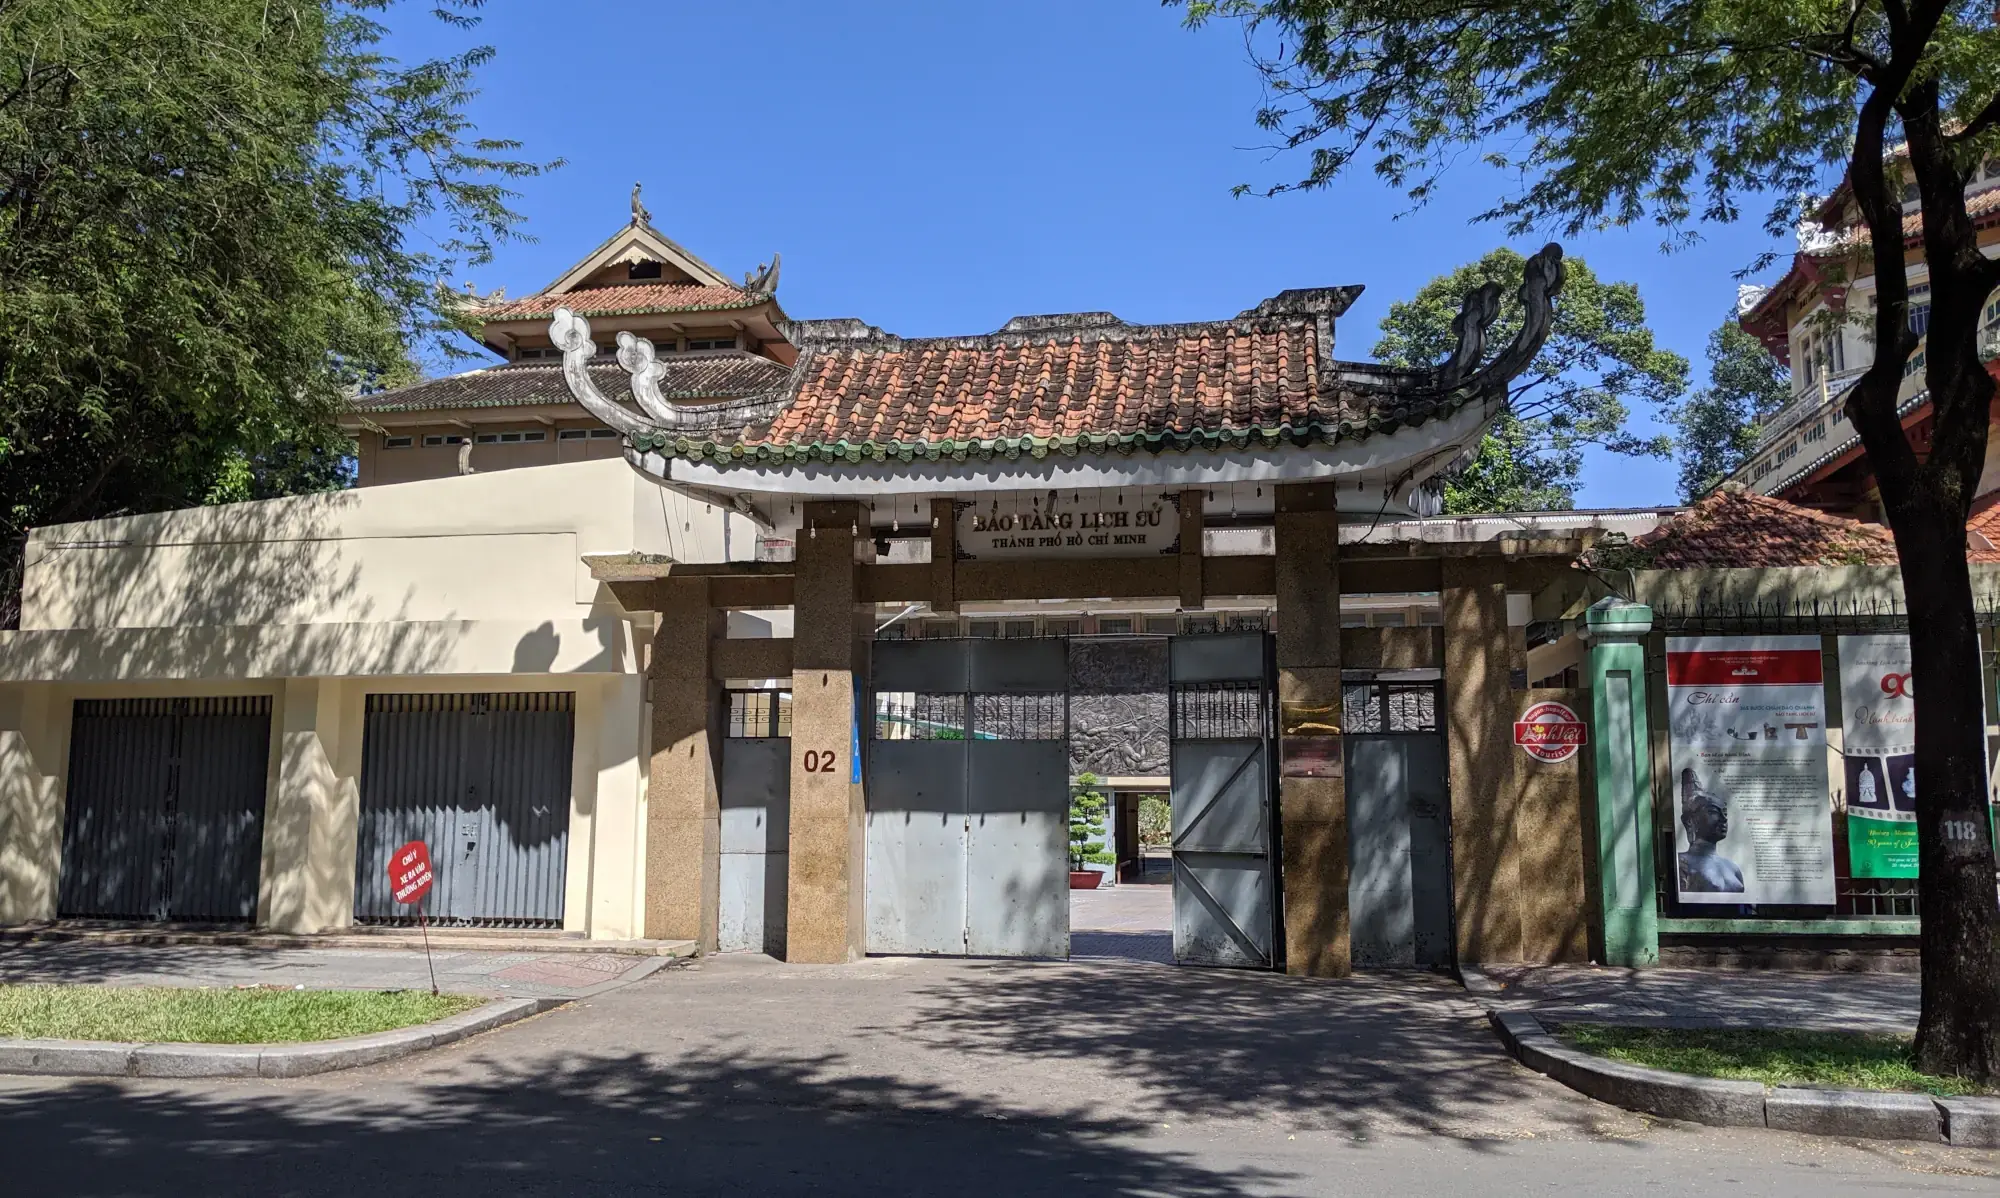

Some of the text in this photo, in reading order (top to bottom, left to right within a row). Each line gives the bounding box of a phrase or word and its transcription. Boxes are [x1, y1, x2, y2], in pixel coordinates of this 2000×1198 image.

[972, 502, 1163, 533] BẢO TÀNG LỊCH SỬ
[992, 530, 1147, 548] THÀNH PHỐ HỒ CHÍ MINH
[804, 750, 835, 772] 02
[1535, 747, 1568, 758] tourist
[1945, 820, 1976, 840] 118
[402, 852, 412, 866] CHÚ
[400, 862, 425, 885] XE RA VÀO
[396, 872, 432, 901] THƯỜNG XUYÊN
